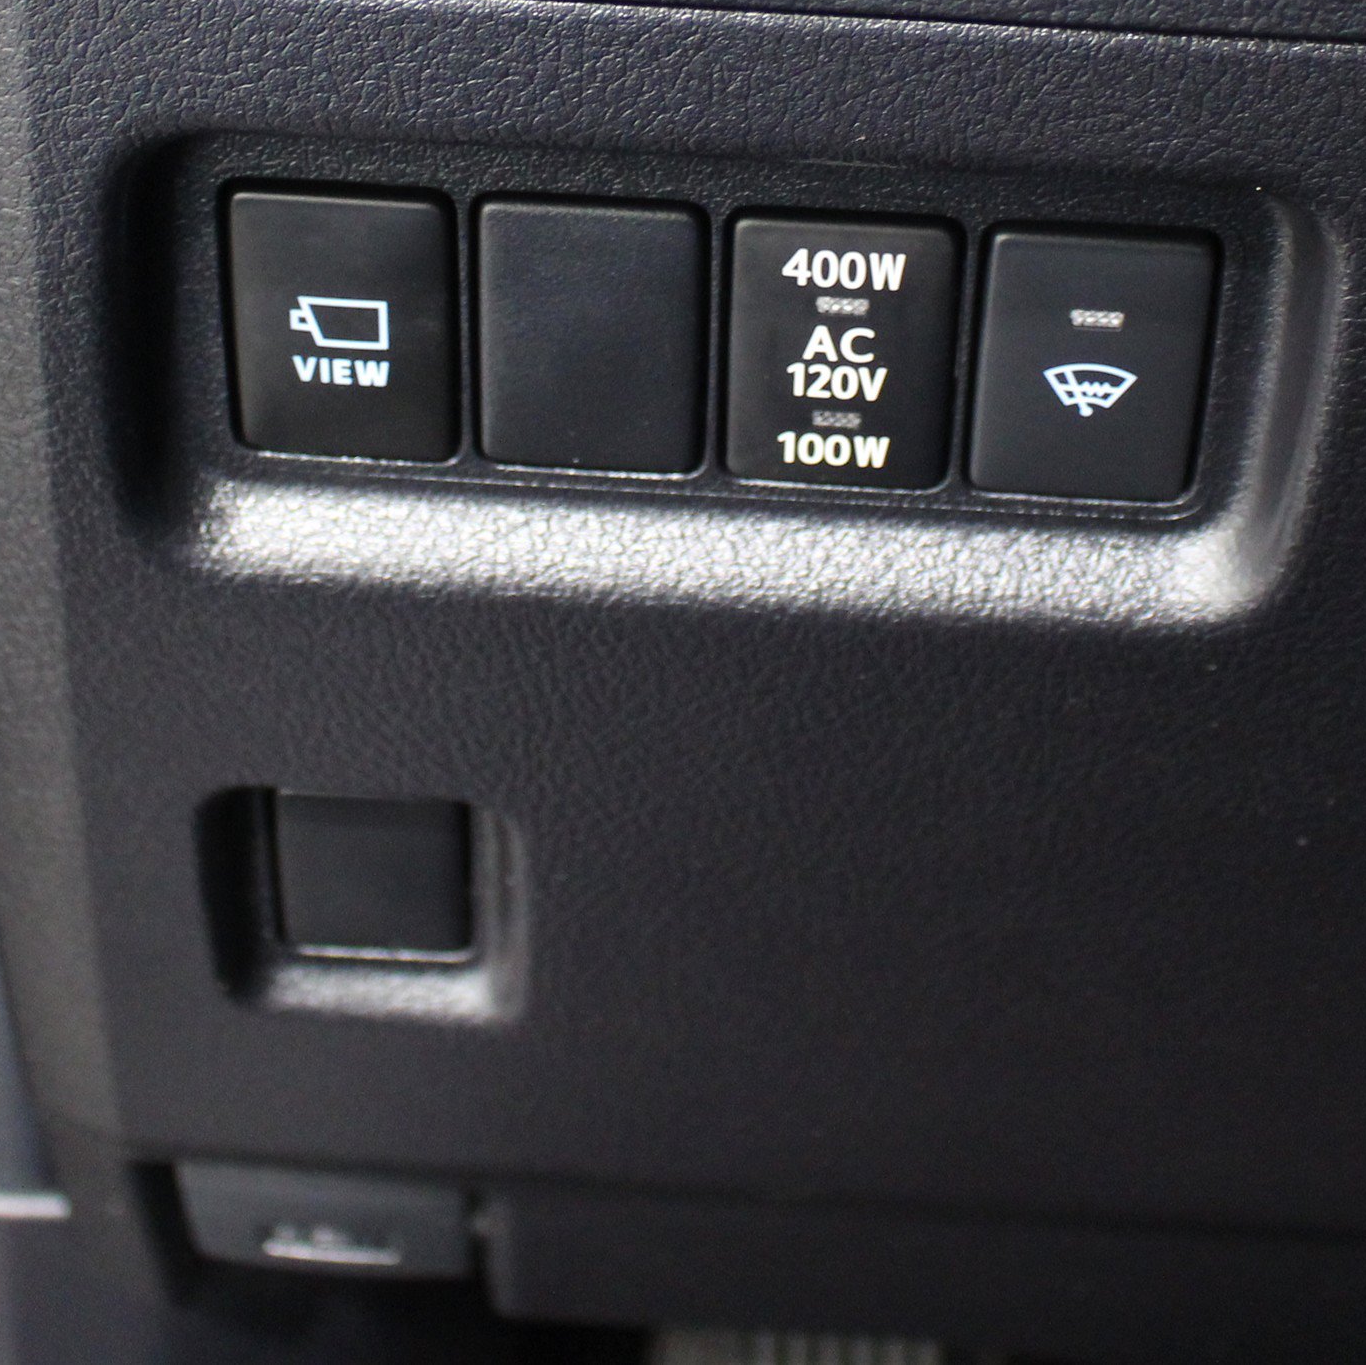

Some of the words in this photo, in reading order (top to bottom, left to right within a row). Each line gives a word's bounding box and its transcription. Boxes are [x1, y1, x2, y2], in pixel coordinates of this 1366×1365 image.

[781, 248, 907, 291] 400W
[802, 325, 876, 364] AC
[291, 354, 390, 388] VIEW
[785, 362, 888, 402] 120V
[777, 430, 890, 469] 100W
